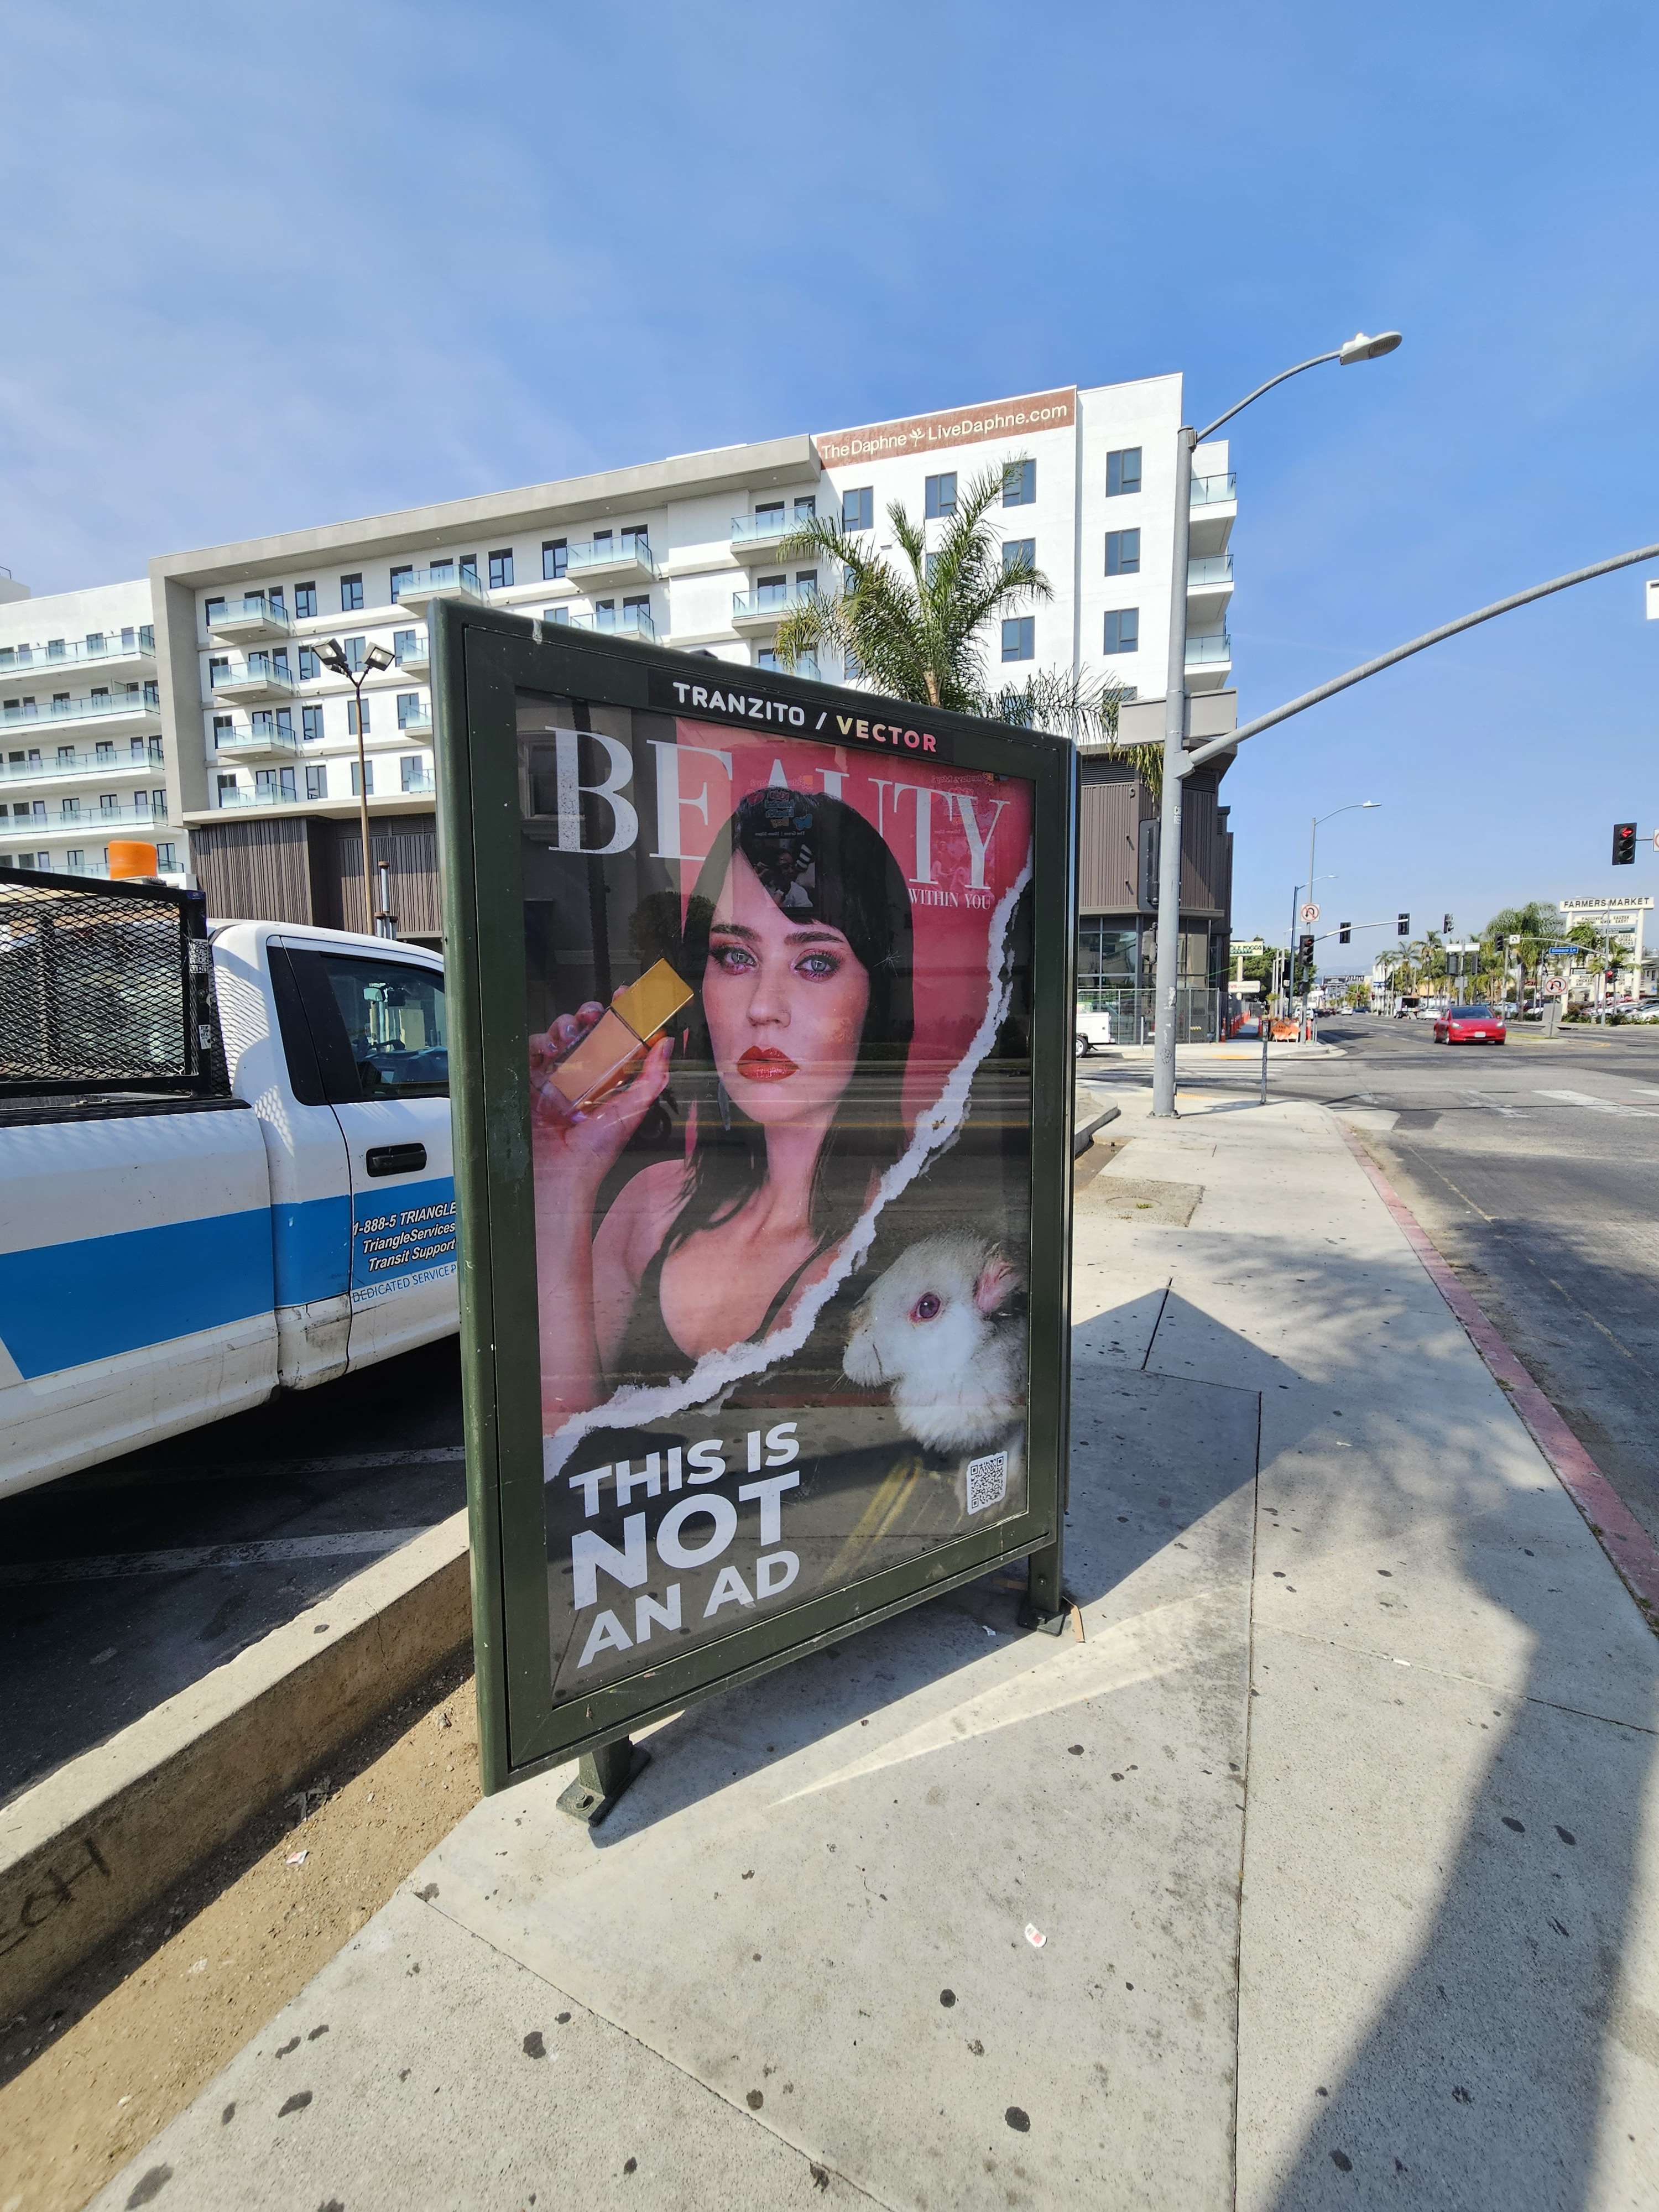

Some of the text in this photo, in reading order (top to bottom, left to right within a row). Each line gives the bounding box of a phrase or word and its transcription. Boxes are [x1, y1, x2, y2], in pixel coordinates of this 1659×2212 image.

[928, 405, 1067, 441] LiveDaphne.com
[672, 682, 805, 726] TRANZITO
[836, 715, 937, 753] VECTOR
[545, 726, 1011, 890] BETY
[907, 888, 992, 910] WITHIN YOU
[1564, 898, 1650, 908] FARMERS MARKET
[353, 1202, 457, 1235] 1-888-5 TRIANGLE
[363, 1223, 456, 1254] TriangleServices
[369, 1238, 456, 1272] Transit Support
[352, 1278, 410, 1303] DEDICATED
[413, 1266, 450, 1285] SERVICE
[569, 1422, 800, 1518] THIS IS
[571, 1470, 800, 1610] NOT
[577, 1551, 800, 1668] AN AD
